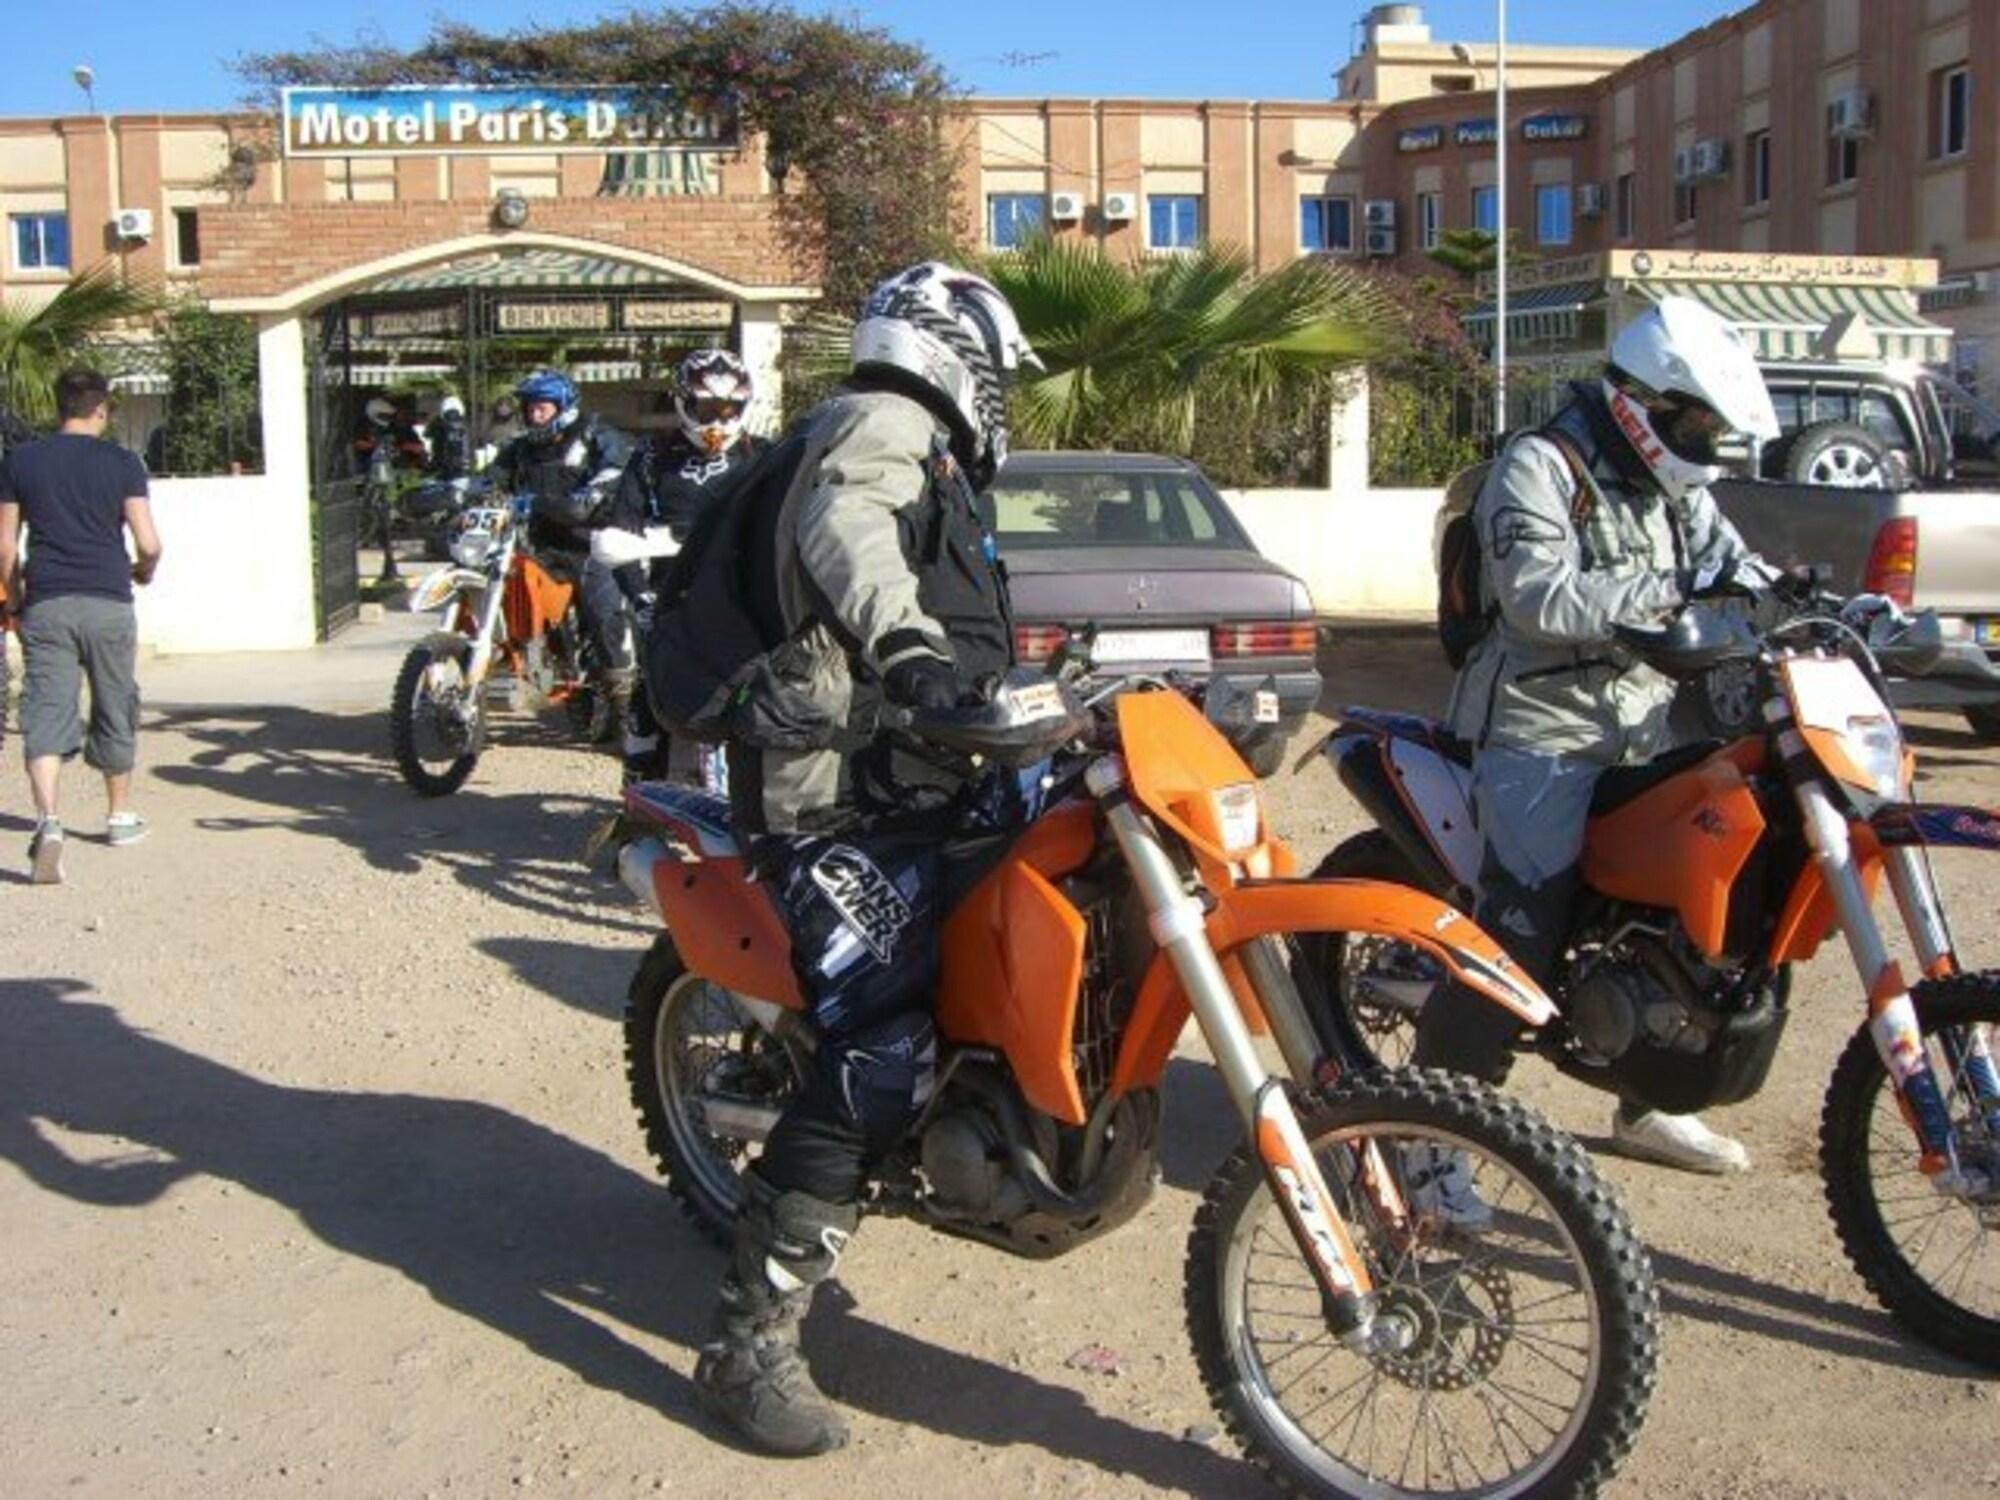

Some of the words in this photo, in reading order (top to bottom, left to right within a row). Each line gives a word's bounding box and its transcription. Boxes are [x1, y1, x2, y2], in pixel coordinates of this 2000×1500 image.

[299, 99, 434, 144] Motel
[448, 99, 569, 142] Paris
[1457, 129, 1498, 145] Pari
